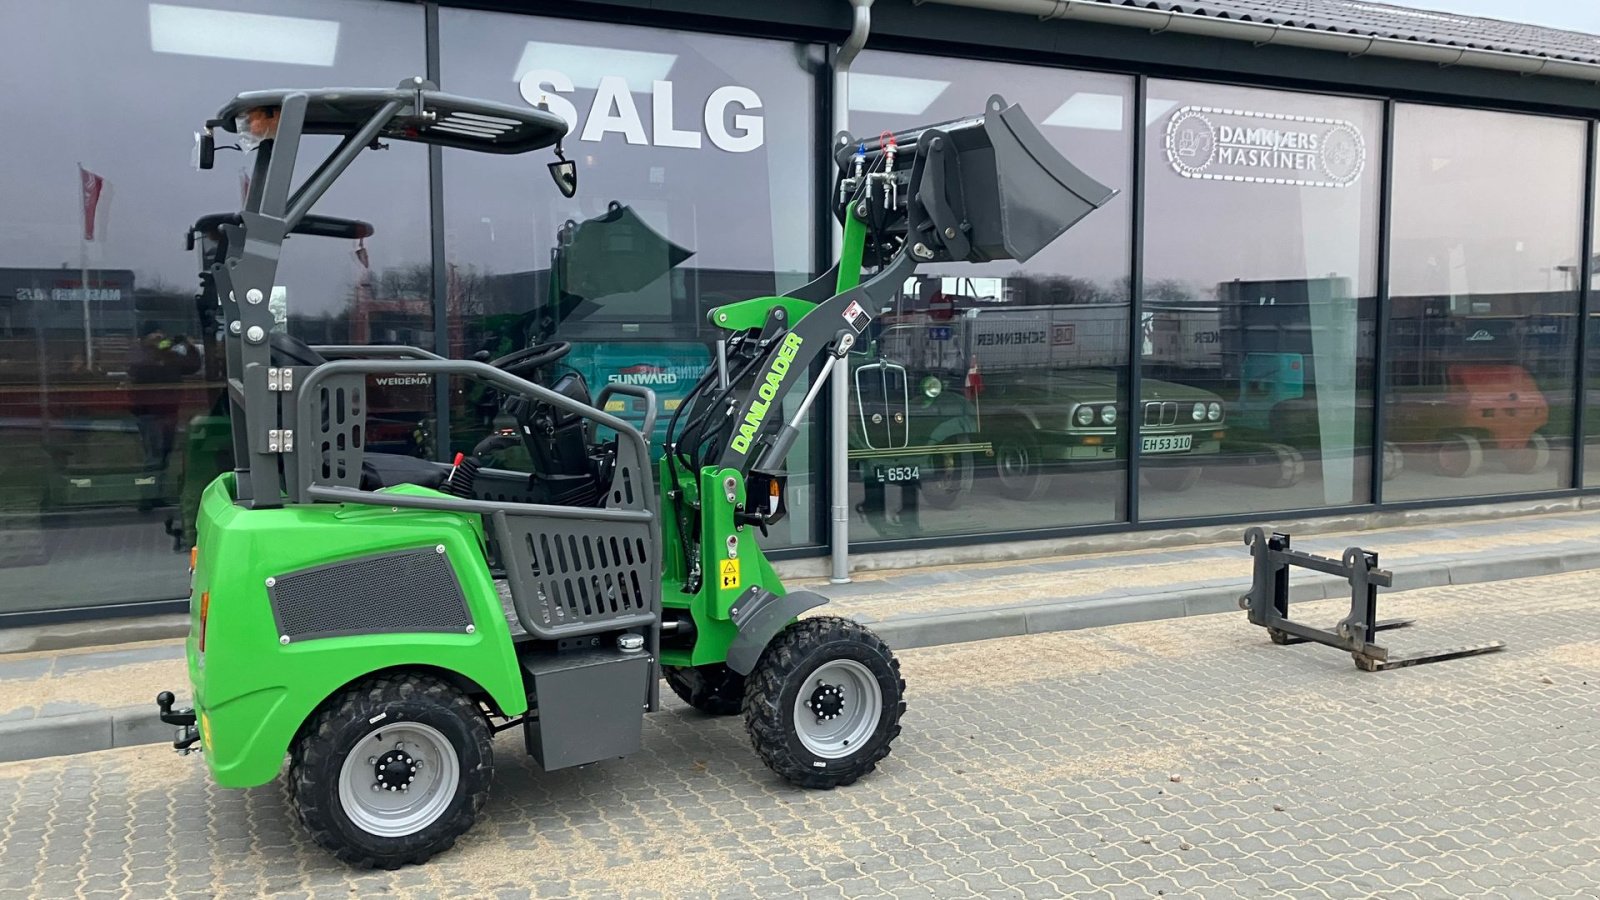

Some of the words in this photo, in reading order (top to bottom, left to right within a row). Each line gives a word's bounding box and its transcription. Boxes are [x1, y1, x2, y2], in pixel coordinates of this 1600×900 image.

[519, 69, 764, 153] SALG
[1219, 126, 1318, 150] DAMKJÆRS
[1218, 148, 1317, 170] MASKINER
[608, 373, 677, 385] SUNWARD
[731, 332, 803, 455] DANLOADER
[1143, 439, 1157, 451] EH
[1158, 438, 1171, 450] 53
[1172, 436, 1190, 449] 310
[888, 466, 920, 481] 6534
